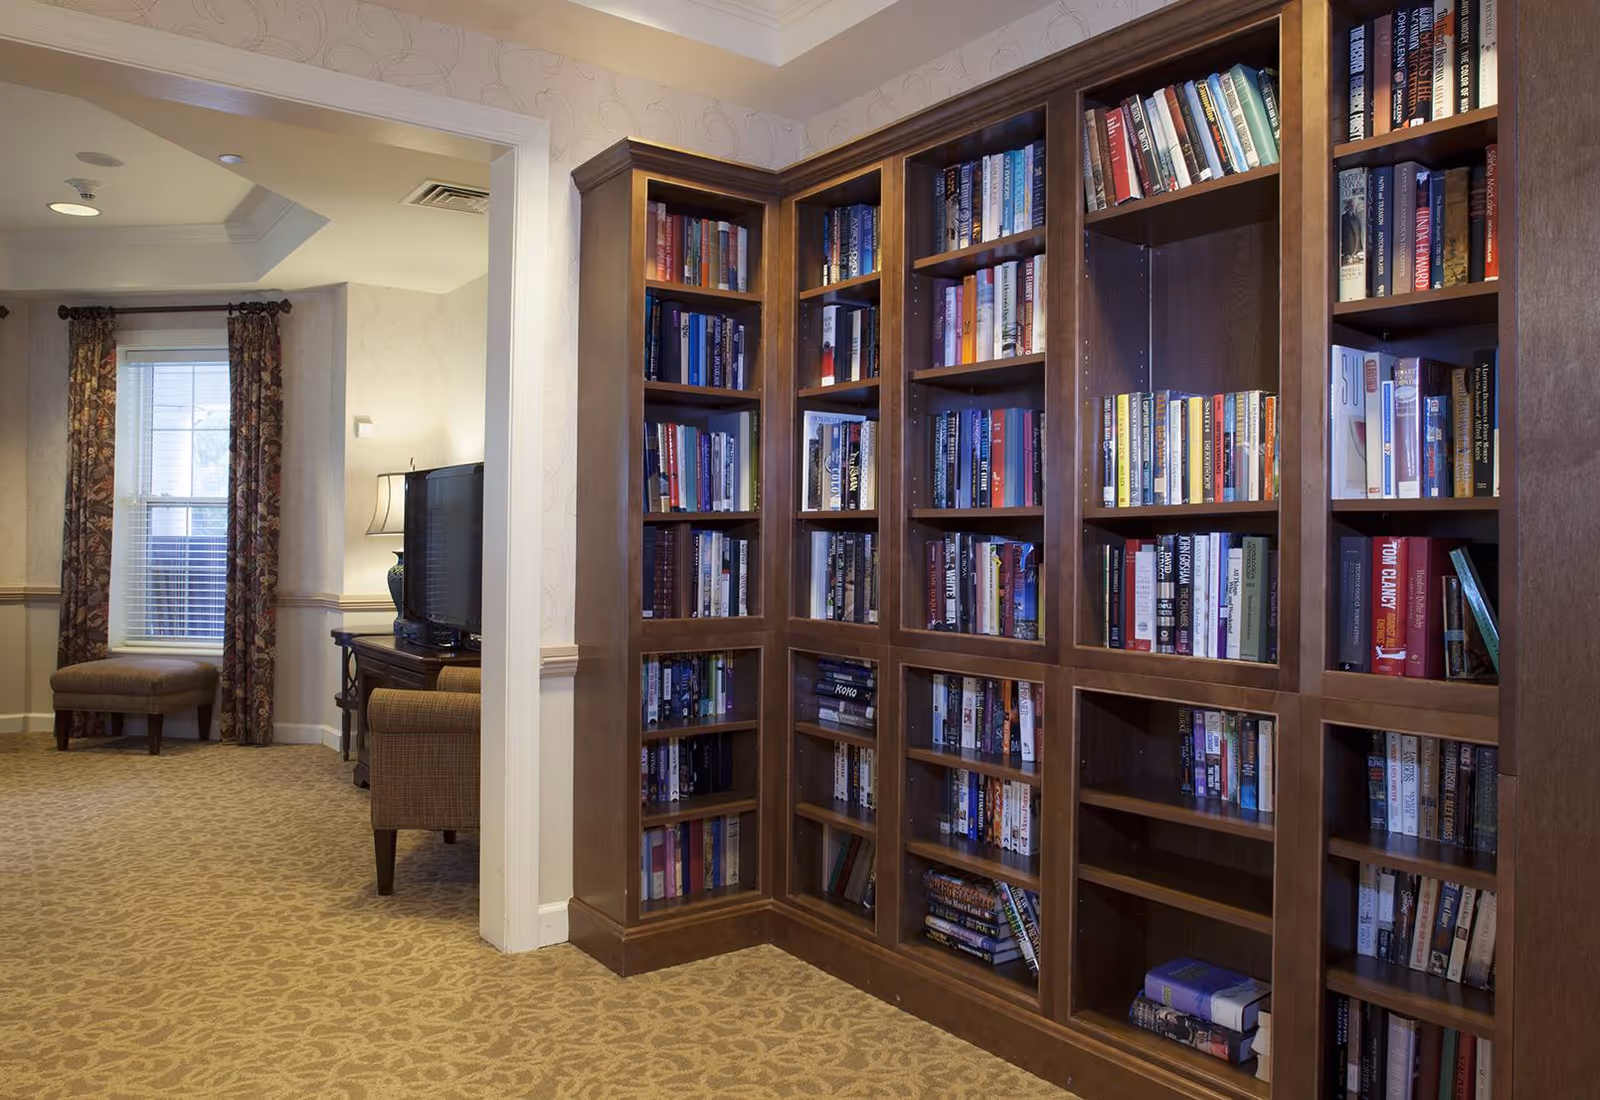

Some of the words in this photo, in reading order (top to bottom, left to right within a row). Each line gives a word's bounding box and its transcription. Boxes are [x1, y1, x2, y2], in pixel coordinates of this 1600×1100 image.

[1397, 11, 1406, 36] JOHN
[1419, 7, 1432, 33] ROBERT
[1460, 17, 1468, 44] LINDSEY
[1350, 25, 1364, 42] THE
[1350, 41, 1364, 74] DECEIVER
[1397, 37, 1405, 68] GLENN
[1418, 32, 1432, 76] SPEAKS
[1460, 50, 1468, 64] THE
[1460, 65, 1469, 86] COLOR
[1350, 75, 1364, 114] FREDERICK
[1417, 80, 1431, 102] THE
[1460, 88, 1469, 97] OF
[1198, 83, 1215, 122] Emmeline
[1211, 124, 1221, 141] Judith
[1415, 210, 1429, 241] LINDA
[1415, 243, 1429, 288] HOWARD
[1025, 276, 1033, 301] FLANNERY
[1156, 393, 1166, 421] DALE
[947, 417, 955, 436] STEVE
[1474, 419, 1482, 439] Alfred
[1156, 425, 1165, 469] BROWN
[1474, 441, 1482, 461] Kazin
[1179, 535, 1191, 554] JOHN
[1381, 541, 1398, 565] TOM
[1164, 552, 1172, 574] DAVID
[1179, 554, 1191, 585] GRISHAM
[930, 588, 936, 597] TO
[946, 569, 956, 597] WHITE
[1180, 587, 1188, 599] THE
[1381, 568, 1397, 610] CLANCY
[1415, 569, 1425, 594] Hundred
[1180, 599, 1188, 627] CHAMBER
[1415, 595, 1425, 613] Dollar
[1376, 618, 1385, 644] ENEMIES
[1386, 612, 1396, 636] AGAINST
[1415, 614, 1424, 629] Baby
[1386, 637, 1395, 648] ALL
[835, 684, 857, 698] KOKO
[1445, 756, 1456, 790] PATTERSON
[1444, 800, 1454, 816] ALEX
[1443, 817, 1454, 840] CROSS
